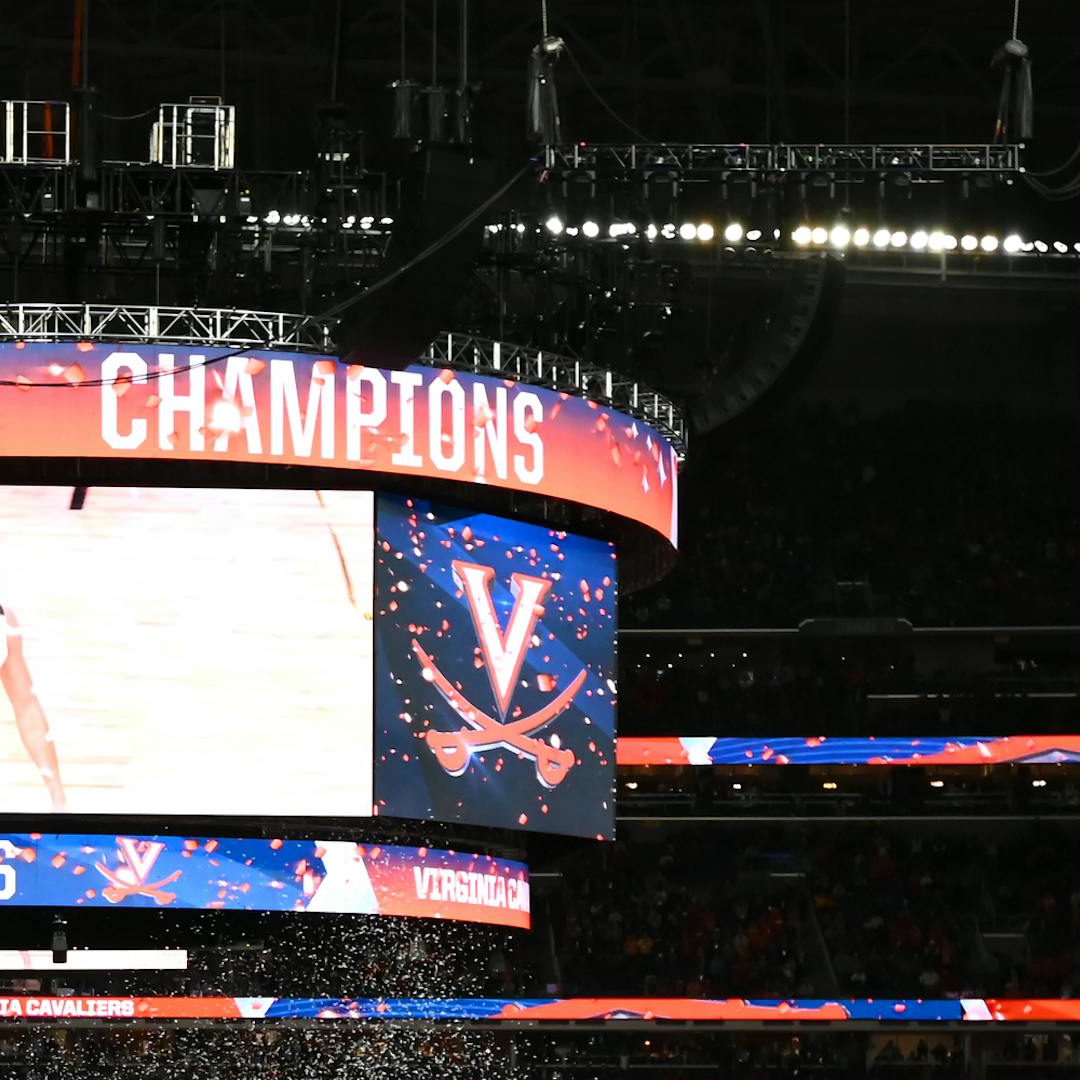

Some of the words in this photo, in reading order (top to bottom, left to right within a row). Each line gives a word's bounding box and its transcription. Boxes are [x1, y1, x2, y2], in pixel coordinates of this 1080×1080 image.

[101, 352, 544, 485] CHAMPIONS
[413, 866, 506, 908] VIRGINIA
[26, 999, 135, 1017] CAVALIERS
